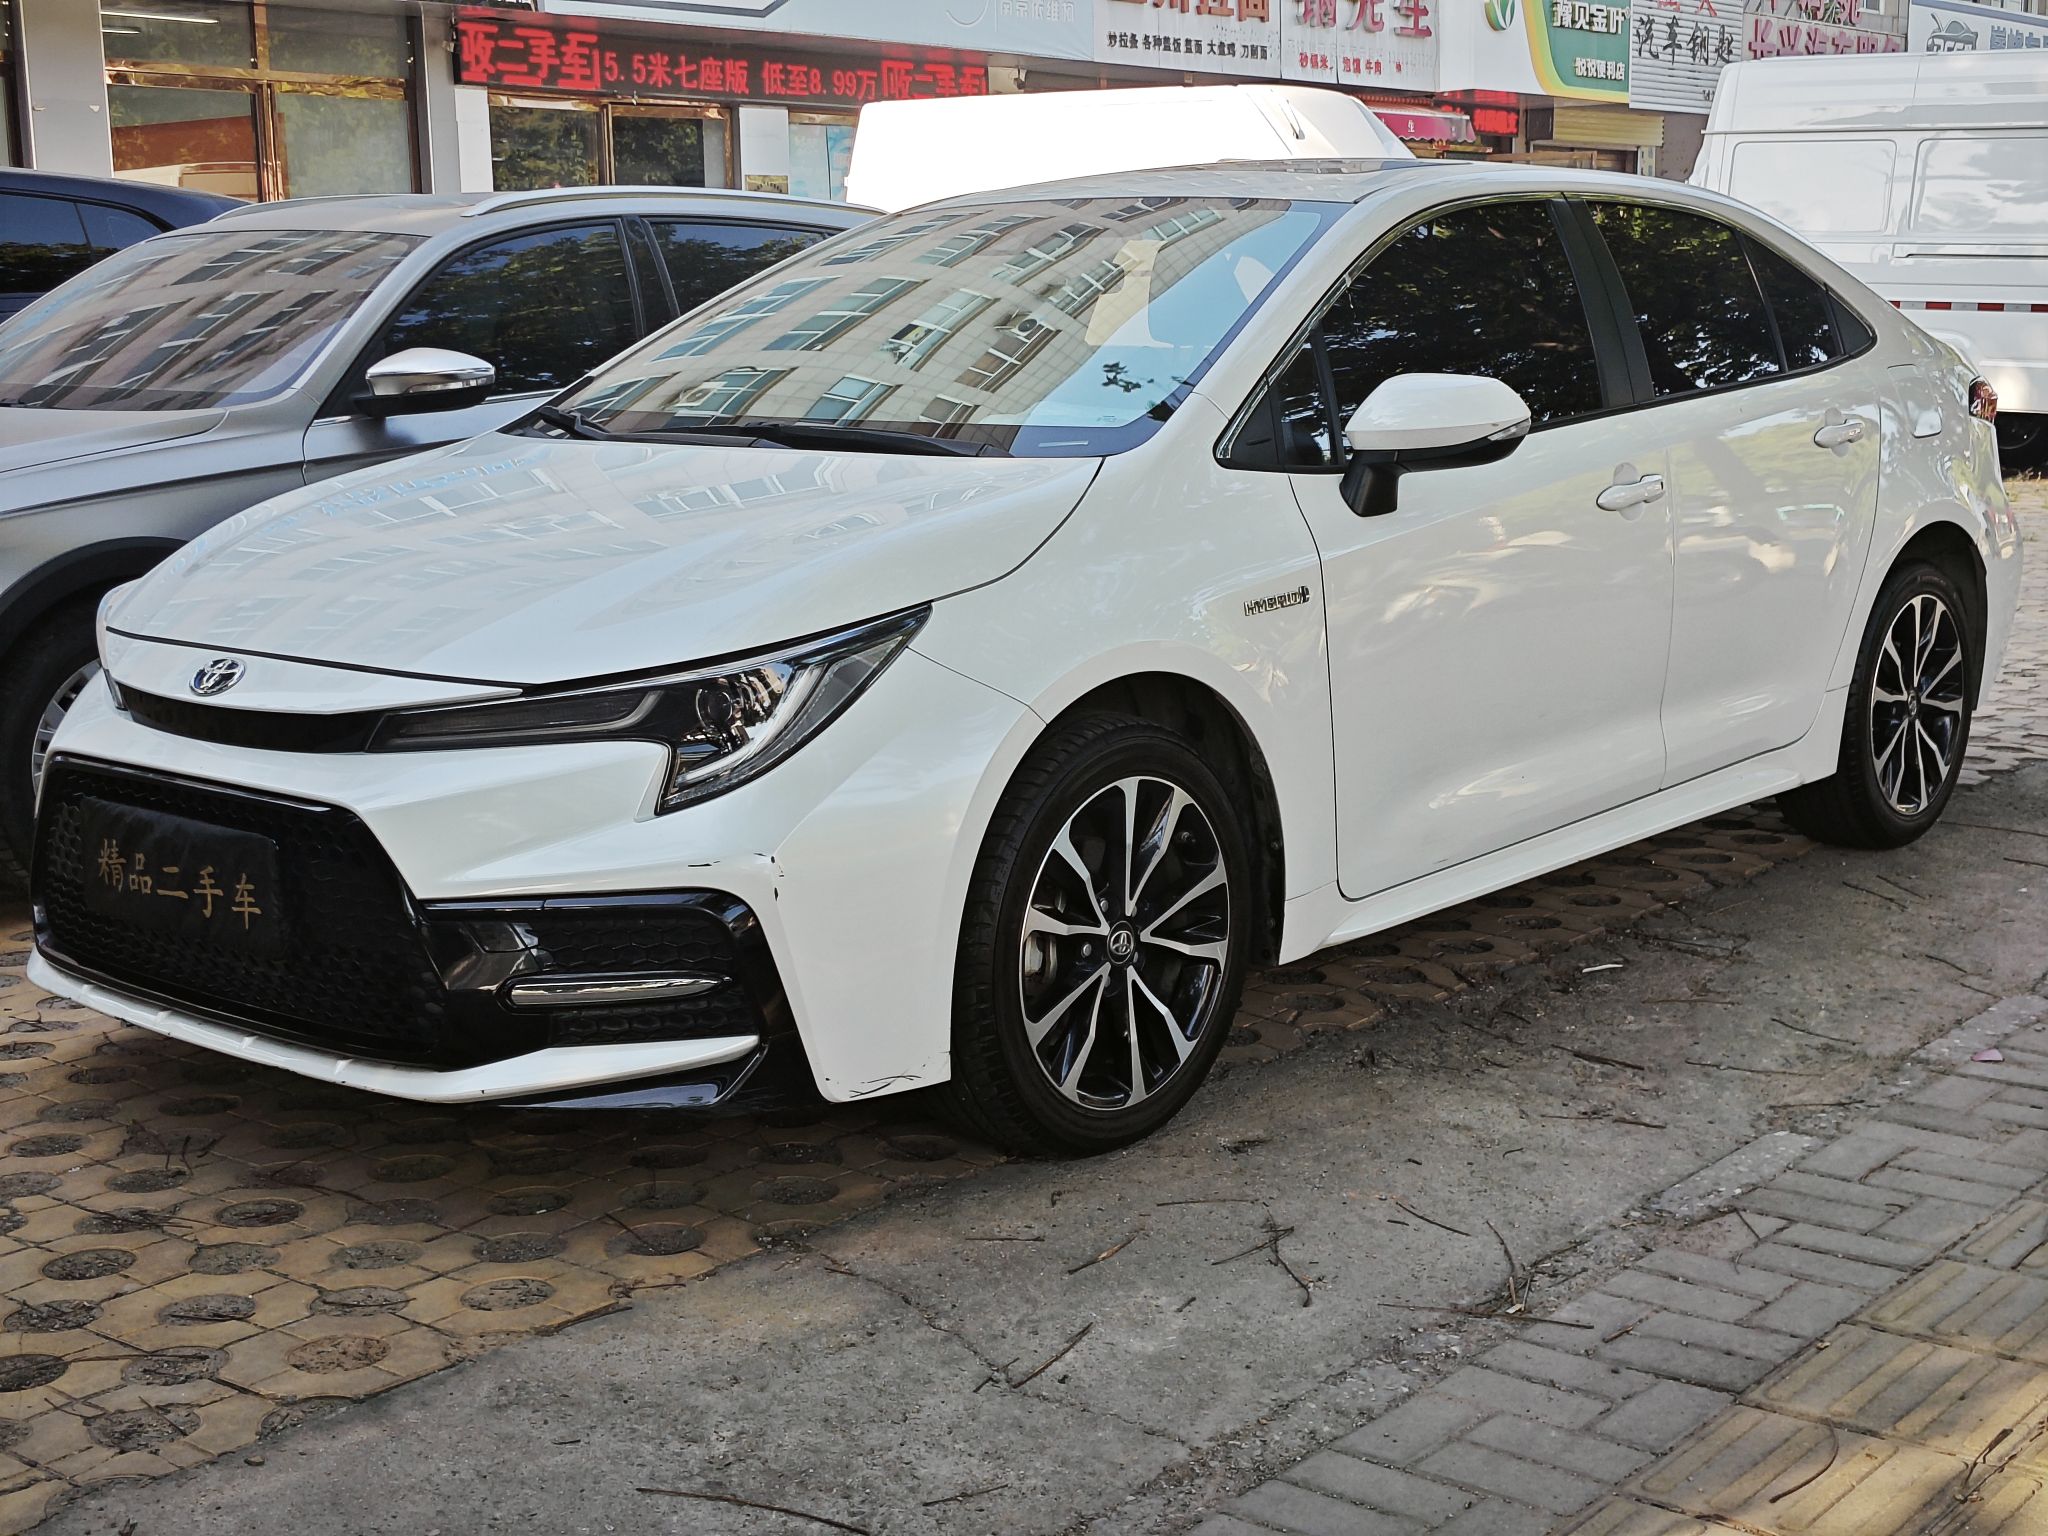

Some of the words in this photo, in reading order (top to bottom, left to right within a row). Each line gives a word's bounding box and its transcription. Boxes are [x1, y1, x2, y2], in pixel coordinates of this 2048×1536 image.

[604, 51, 750, 95] 5.5米七座版
[762, 60, 878, 100] 低至8.99万
[98, 838, 263, 930] 精品二手车
